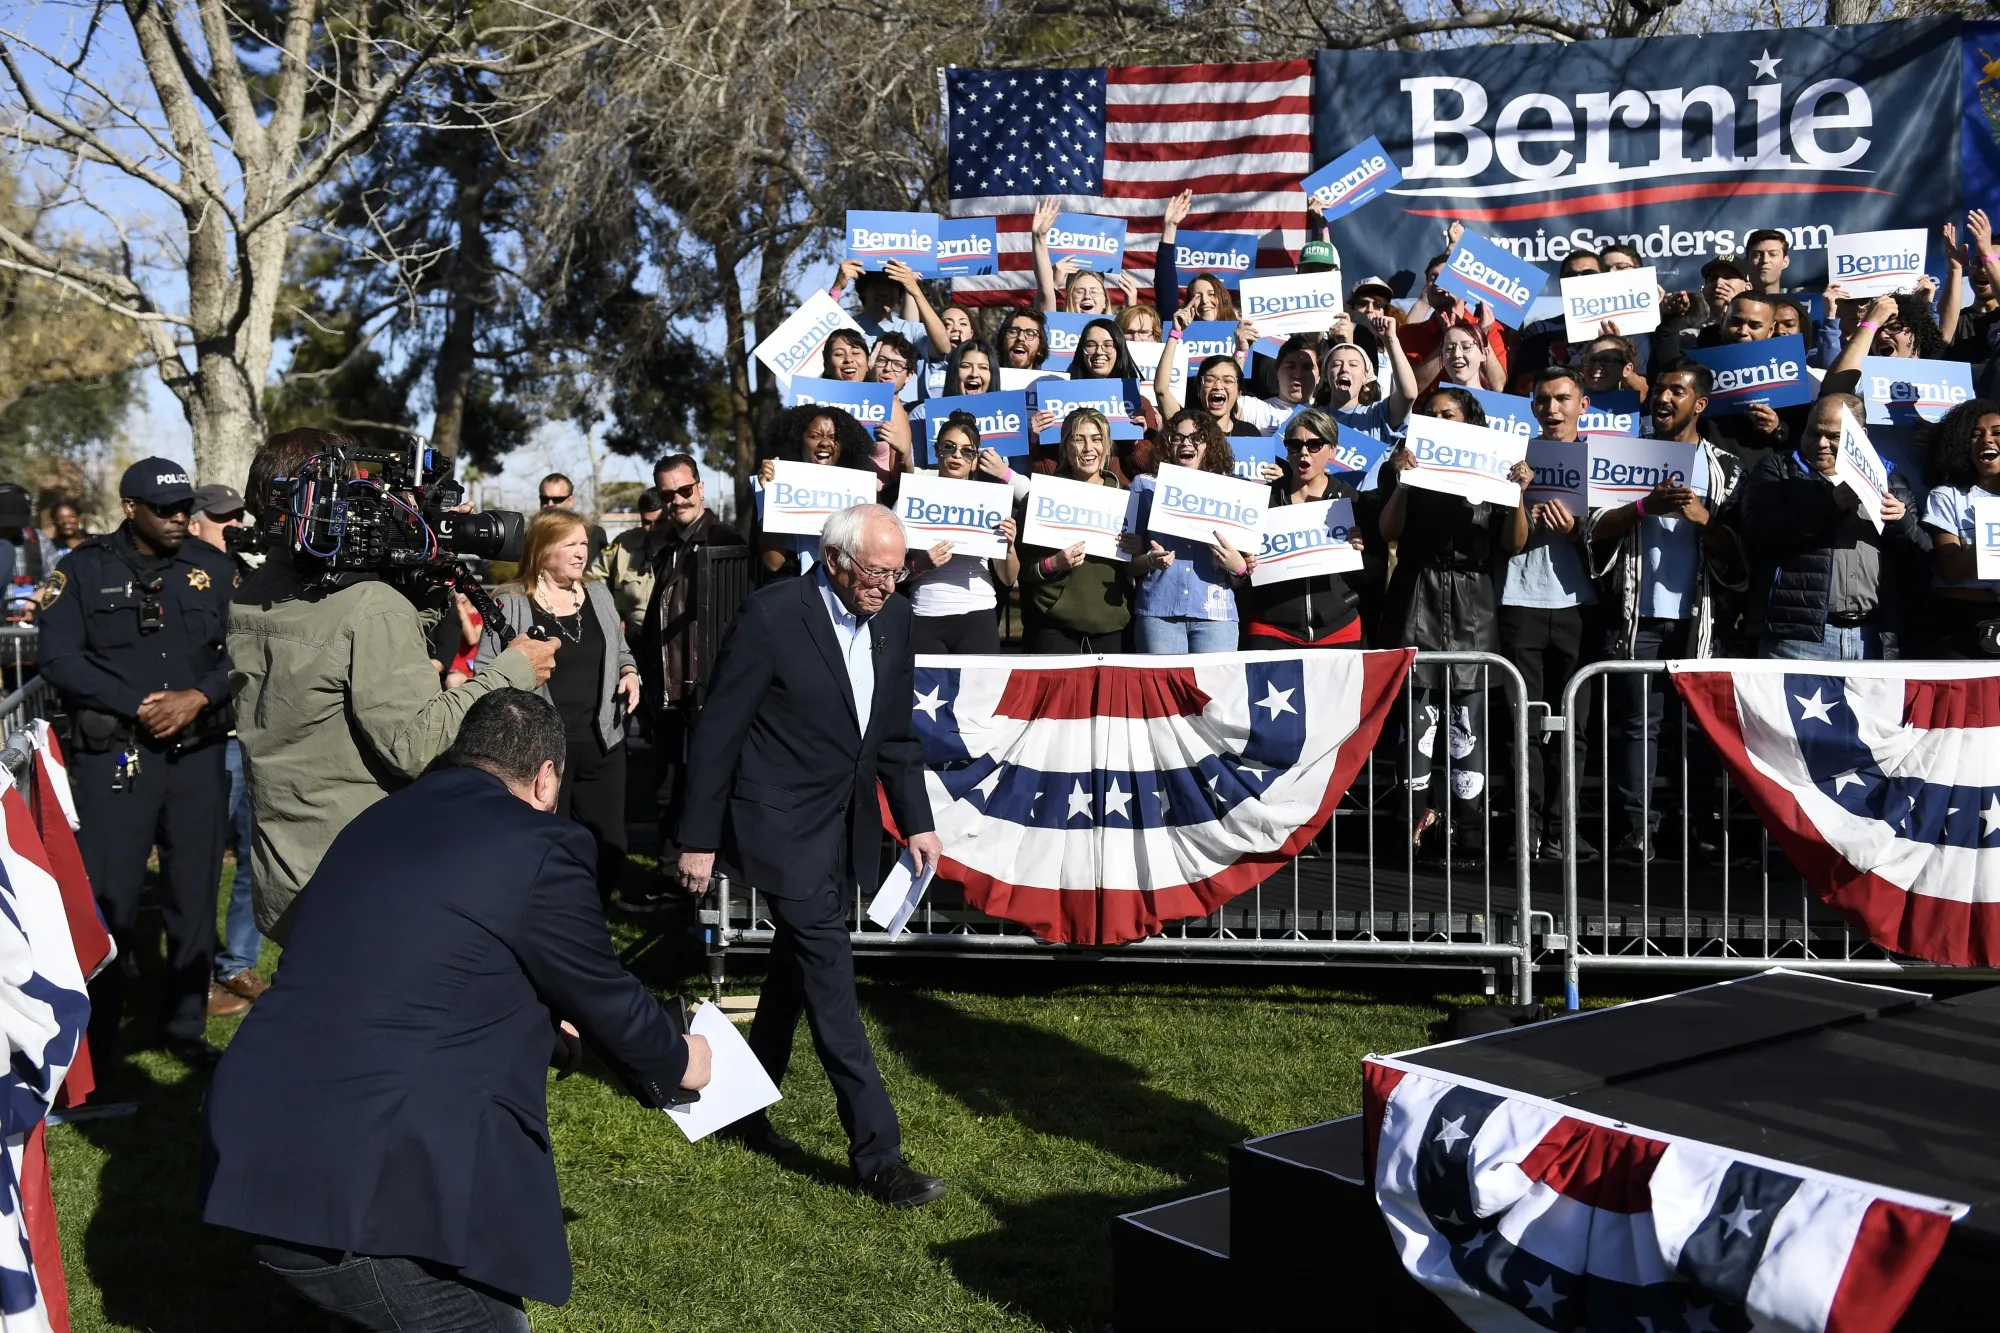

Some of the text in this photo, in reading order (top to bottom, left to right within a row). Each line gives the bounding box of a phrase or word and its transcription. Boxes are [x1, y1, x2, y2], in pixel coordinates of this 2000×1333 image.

[1400, 48, 1873, 181] Bernie
[1314, 155, 1387, 204] Bernie
[852, 228, 932, 253] Bernie
[937, 234, 992, 256] ernie
[1047, 226, 1119, 254] Bernie
[1175, 247, 1250, 270] Bernie
[1836, 248, 1920, 275] Bernie
[1452, 247, 1530, 307] Bernie
[1248, 289, 1335, 315] Bernie
[1570, 288, 1651, 318] Bernie
[772, 311, 841, 374] Bernie
[1178, 336, 1237, 356] erni
[1871, 376, 1967, 402] Bernie
[932, 409, 1020, 438] nie
[1576, 408, 1632, 432] rnie
[1415, 437, 1515, 480] Bernie
[1589, 457, 1685, 488] Bernie
[1531, 462, 1581, 489] rnie
[905, 496, 1002, 530] Bernie
[1034, 496, 1129, 533] Bernie
[1161, 485, 1259, 525] Bernie
